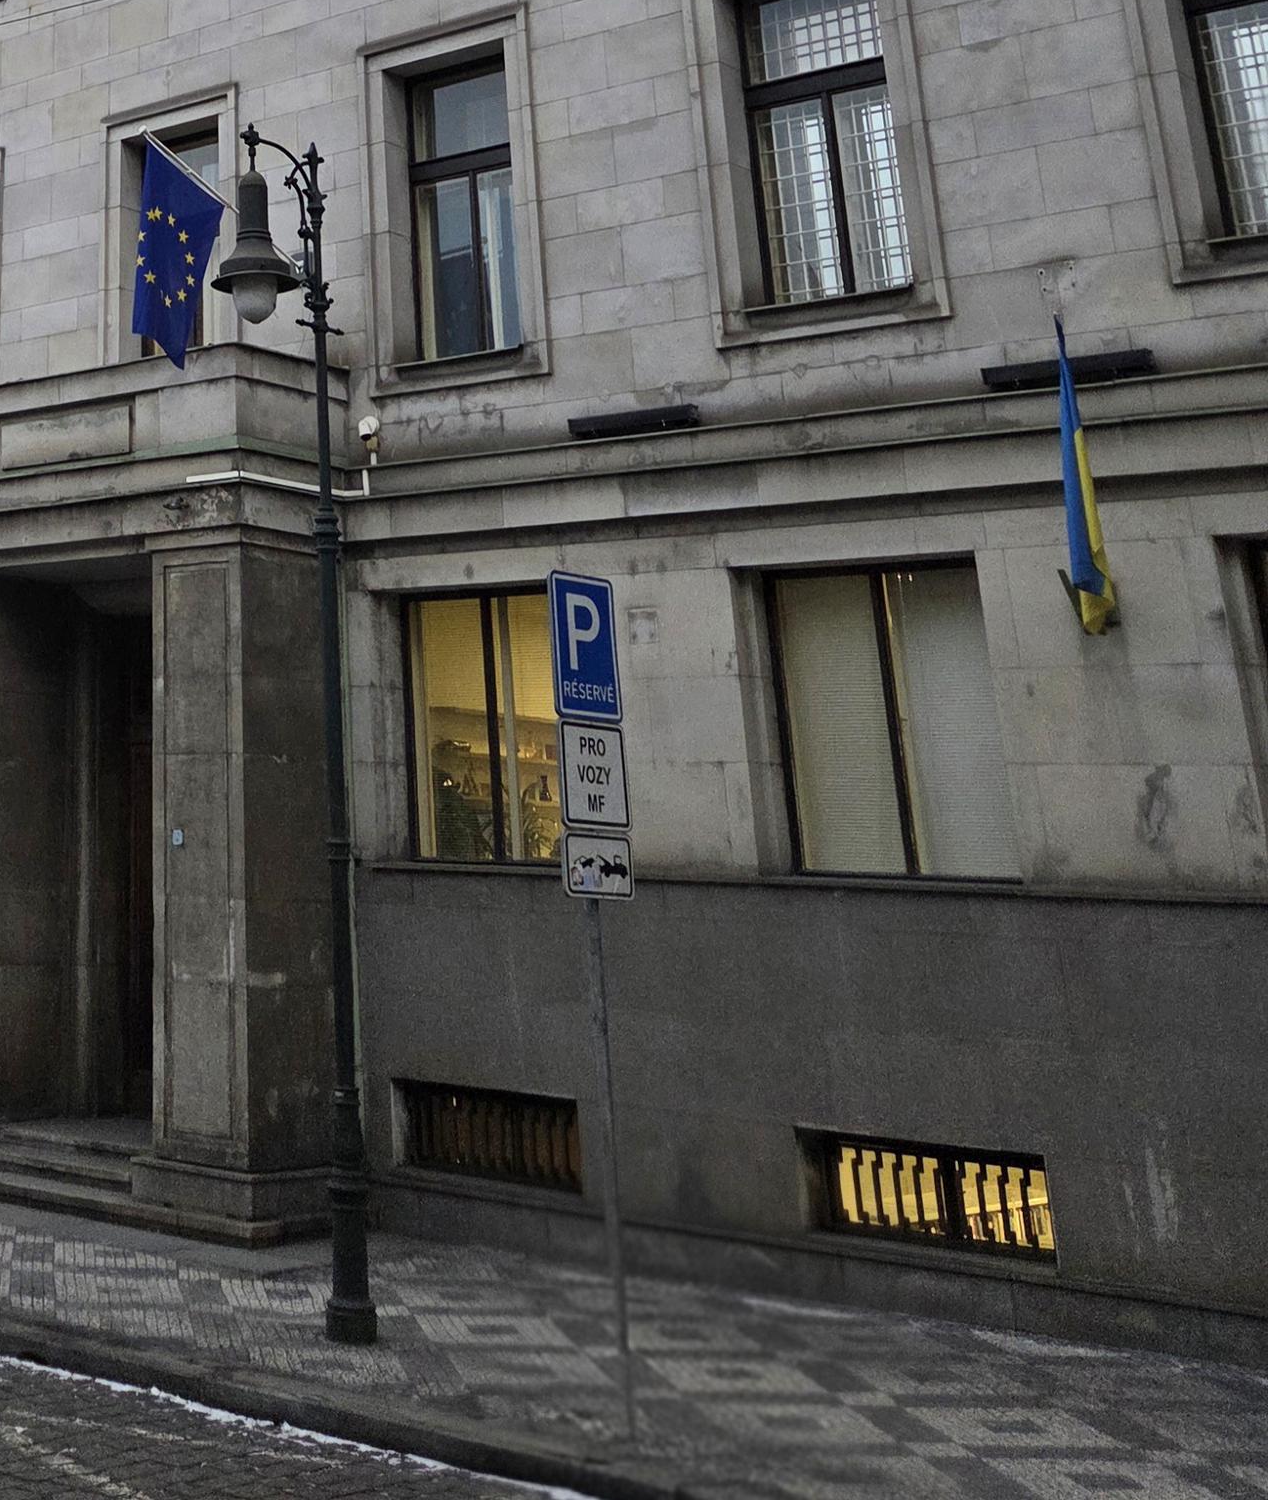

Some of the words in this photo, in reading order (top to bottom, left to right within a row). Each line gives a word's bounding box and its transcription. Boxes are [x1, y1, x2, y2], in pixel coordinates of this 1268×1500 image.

[565, 592, 600, 670] P
[563, 678, 615, 703] RÉSERVÉ
[579, 736, 606, 757] PRO
[577, 764, 611, 786] VOZY
[587, 793, 605, 813] MF
